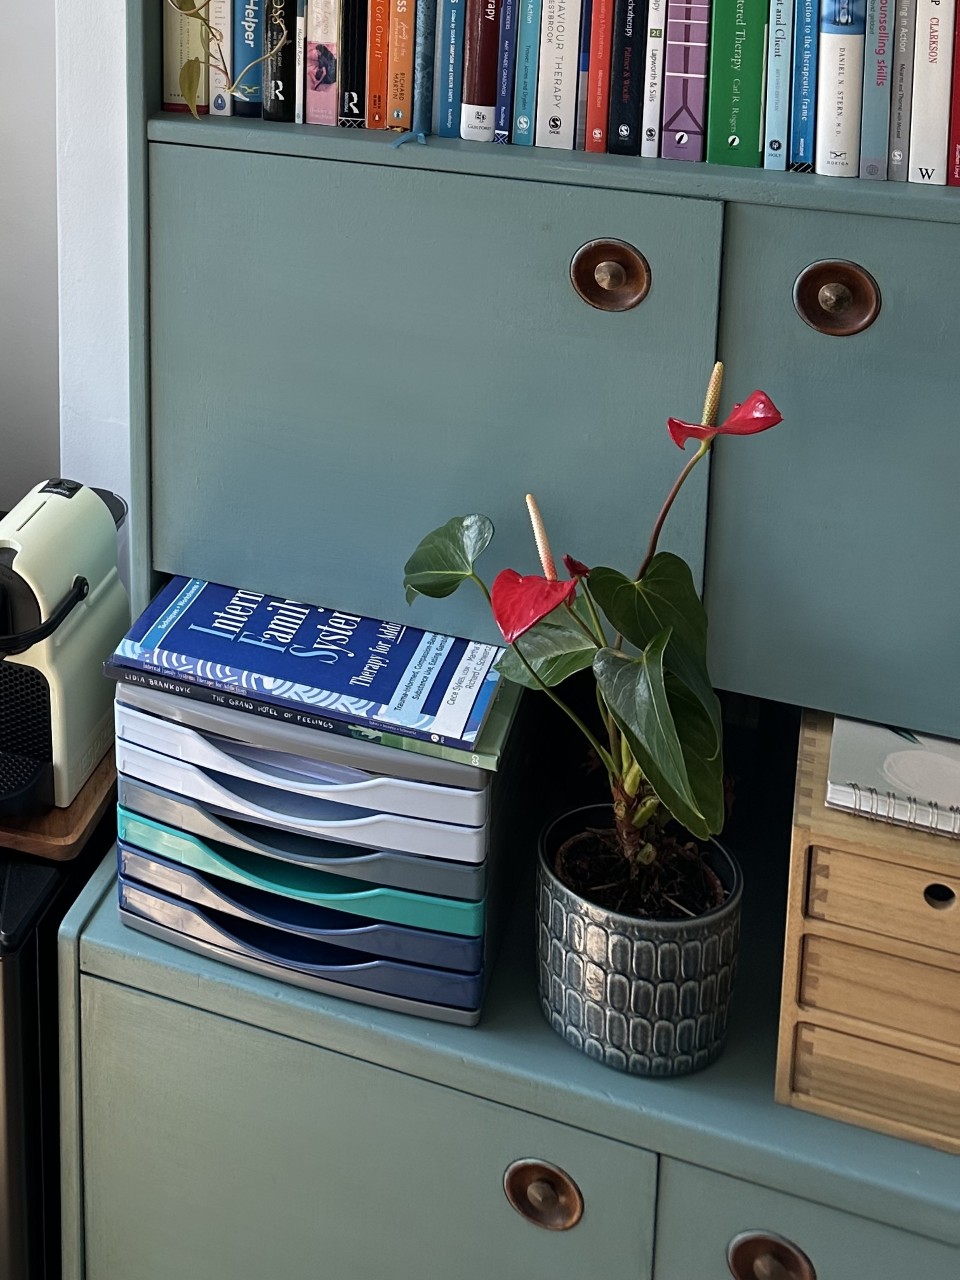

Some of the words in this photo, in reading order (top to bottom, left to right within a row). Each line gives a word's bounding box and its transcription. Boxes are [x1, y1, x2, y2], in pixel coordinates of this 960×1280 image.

[526, 3, 534, 24] Action
[775, 8, 786, 26] and
[900, 18, 908, 26] in
[804, 25, 811, 33] to
[899, 27, 908, 52] Action
[928, 17, 939, 64] CLARKSON
[730, 29, 746, 71] Therapy
[774, 28, 786, 58] Client
[804, 36, 813, 49] the
[649, 48, 658, 80] Lapworth
[801, 51, 812, 96] therapeutic
[838, 47, 846, 76] DANIEL
[876, 59, 888, 87] skills
[553, 55, 564, 109] THERAPY
[732, 78, 740, 94] Carl
[837, 79, 845, 87] N.
[732, 95, 739, 104] R.
[801, 97, 810, 121] frame
[835, 90, 844, 119] STERN,
[729, 107, 739, 133] Rogers
[918, 167, 935, 180] W
[188, 589, 265, 642] Intern
[237, 600, 311, 654] Famil
[378, 621, 402, 641] Addi
[369, 641, 387, 654] for
[349, 654, 390, 687] Therapy
[124, 673, 146, 684] LIDIA
[212, 694, 225, 703] THE
[228, 698, 254, 710] GRAND
[257, 704, 278, 716] HOTEL
[297, 715, 334, 730] FEELINGS
